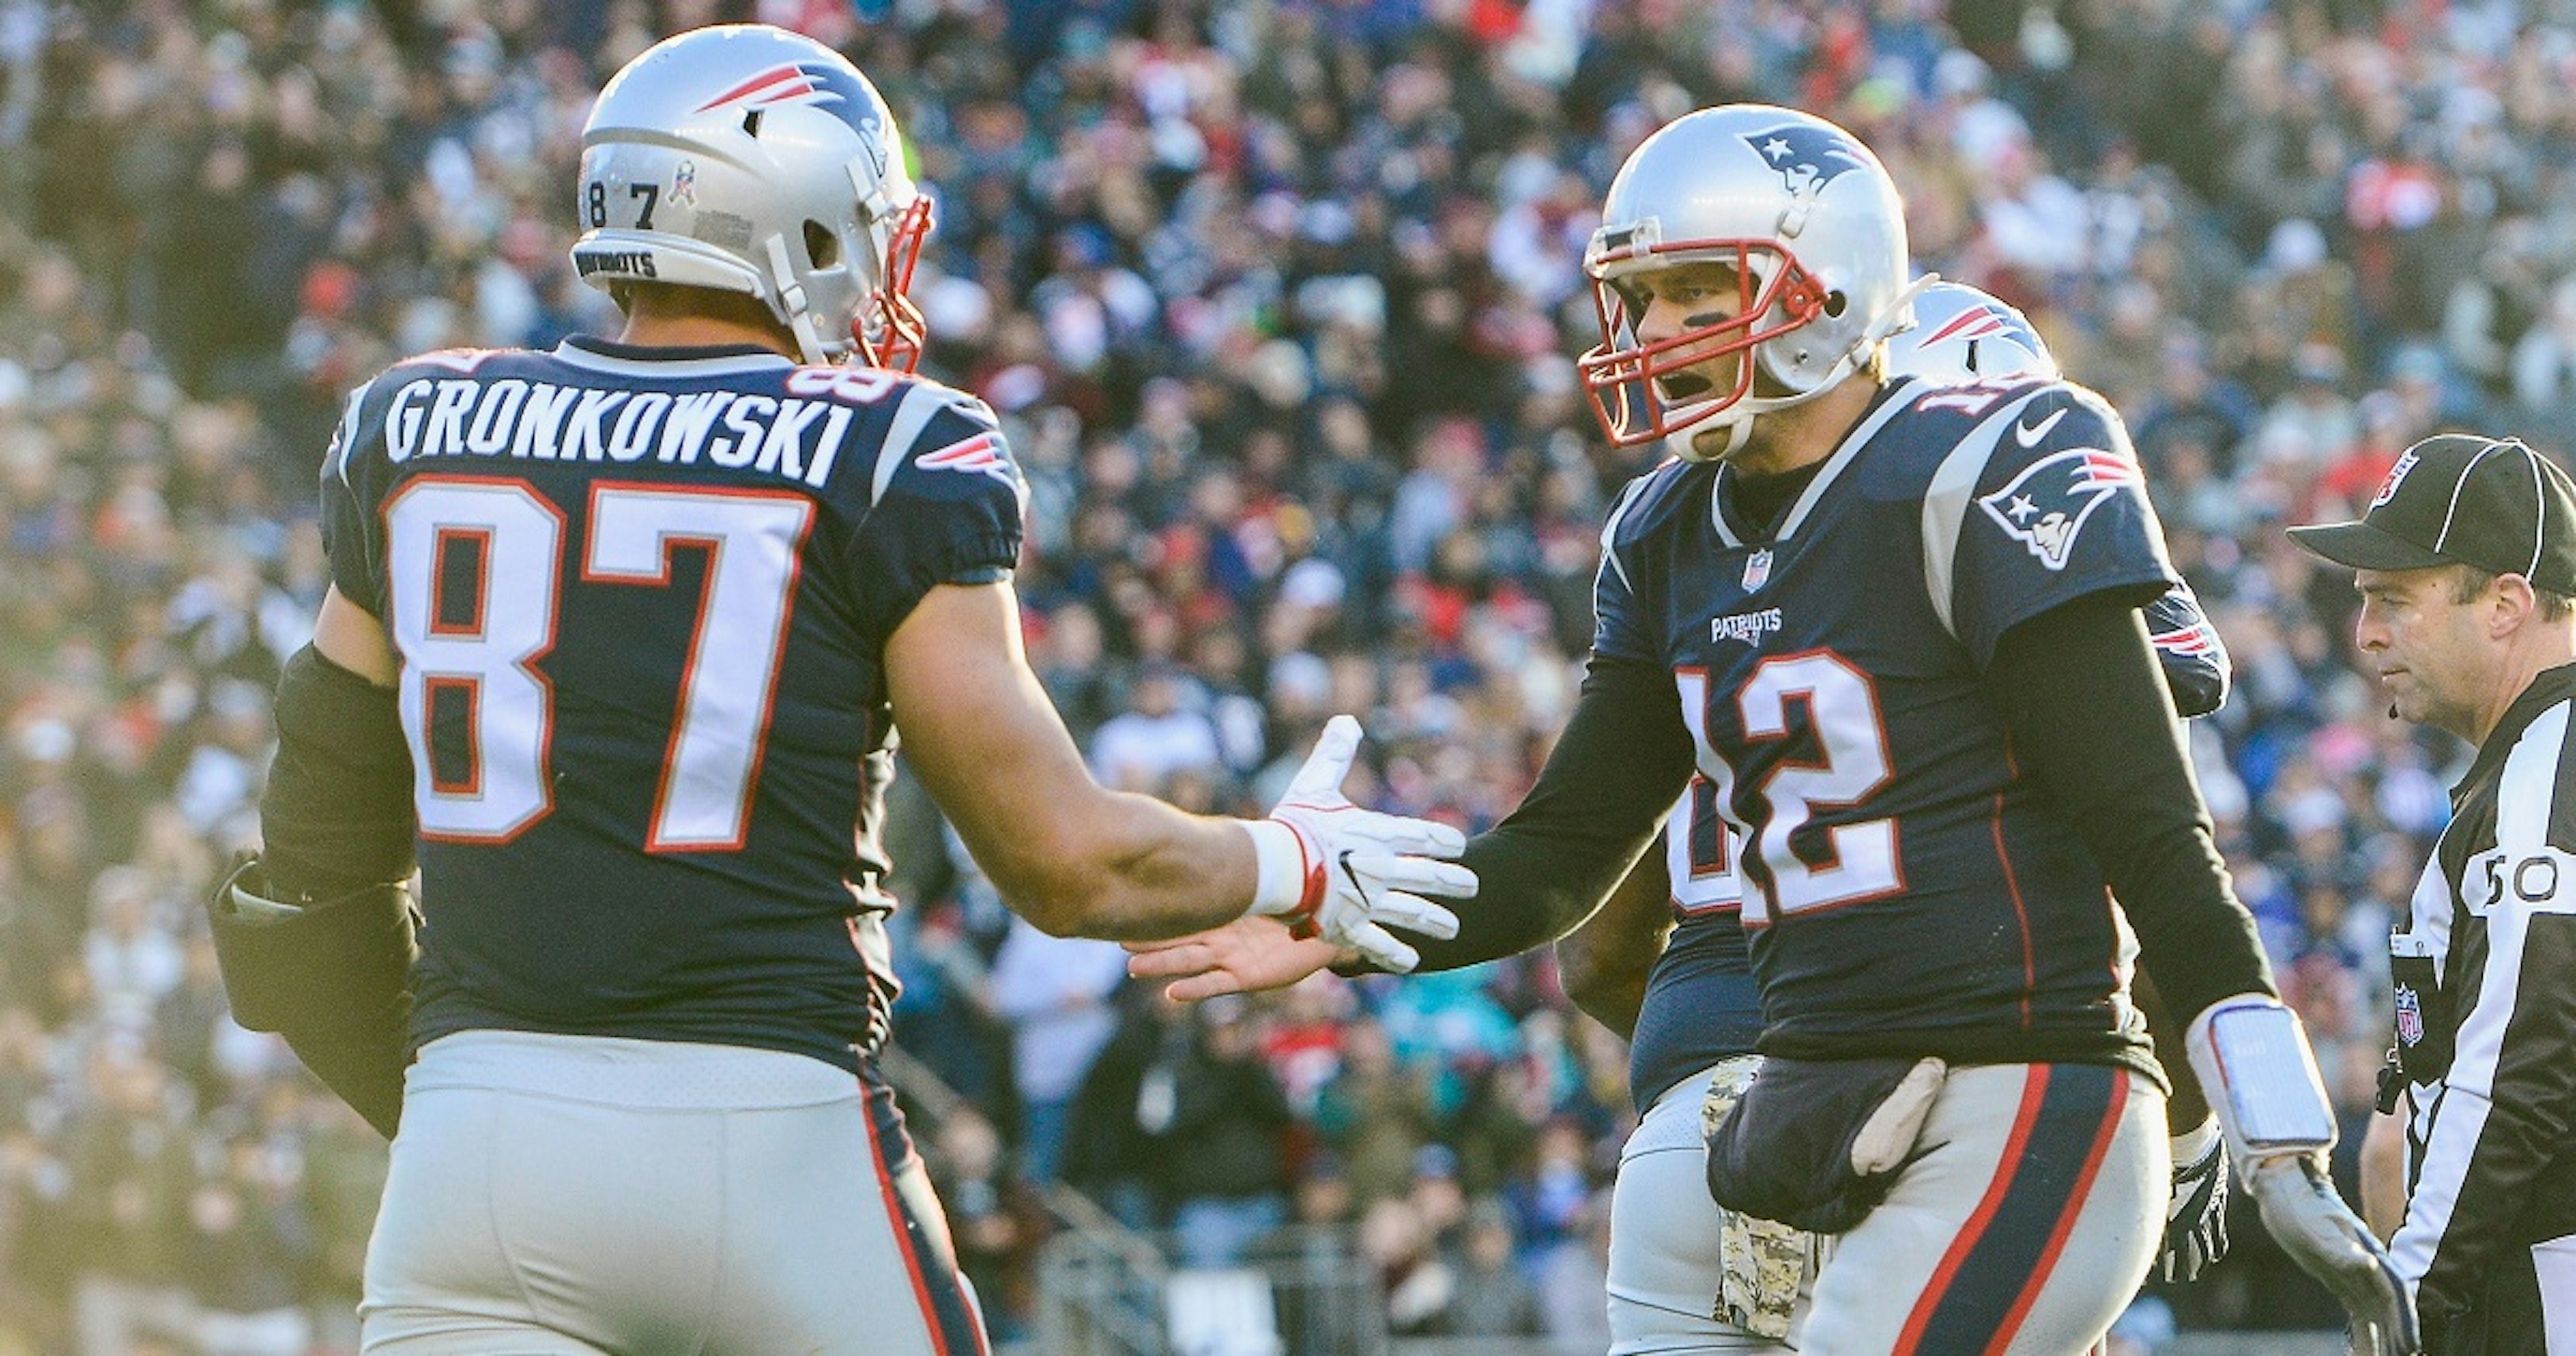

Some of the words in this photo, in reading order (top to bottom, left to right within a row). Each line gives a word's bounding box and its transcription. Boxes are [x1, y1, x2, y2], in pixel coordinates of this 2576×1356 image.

[385, 378, 853, 488] GRONKOWSKI
[379, 473, 814, 853] 87
[1711, 607, 1782, 643] PATRIOTS
[2483, 855, 2558, 908] 50
